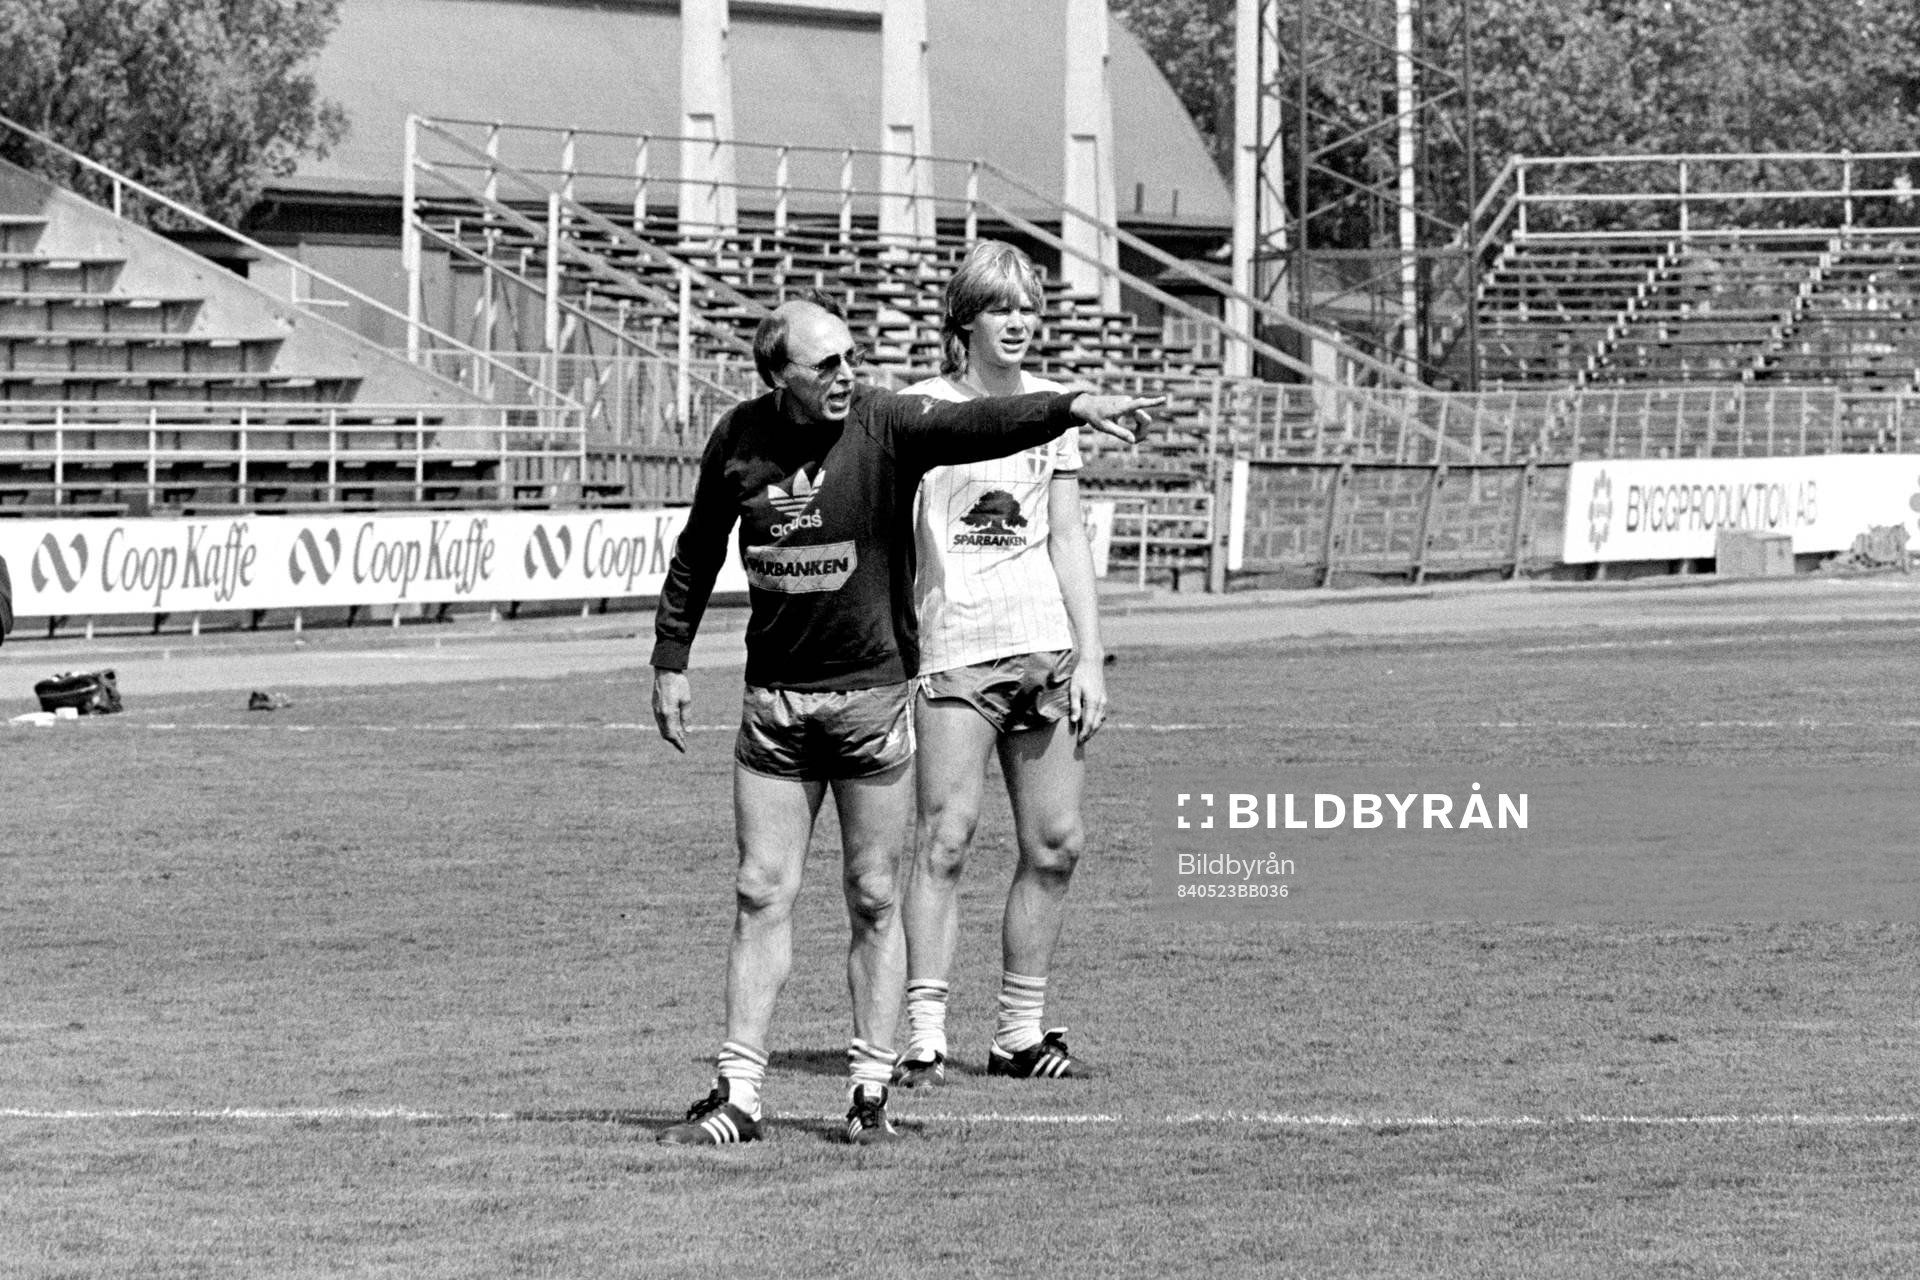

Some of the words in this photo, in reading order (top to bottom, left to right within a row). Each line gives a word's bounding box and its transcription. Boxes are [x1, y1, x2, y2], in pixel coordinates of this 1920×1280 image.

[953, 533, 1027, 547] SPARBANKEN
[1626, 483, 1790, 532] BYGGPRODUKTION
[1795, 480, 1817, 528] AB
[101, 527, 178, 608] Coop
[180, 521, 257, 603] Kaffe
[353, 521, 422, 599] Coop
[424, 518, 495, 595] Kaffe
[583, 518, 647, 592] Coop
